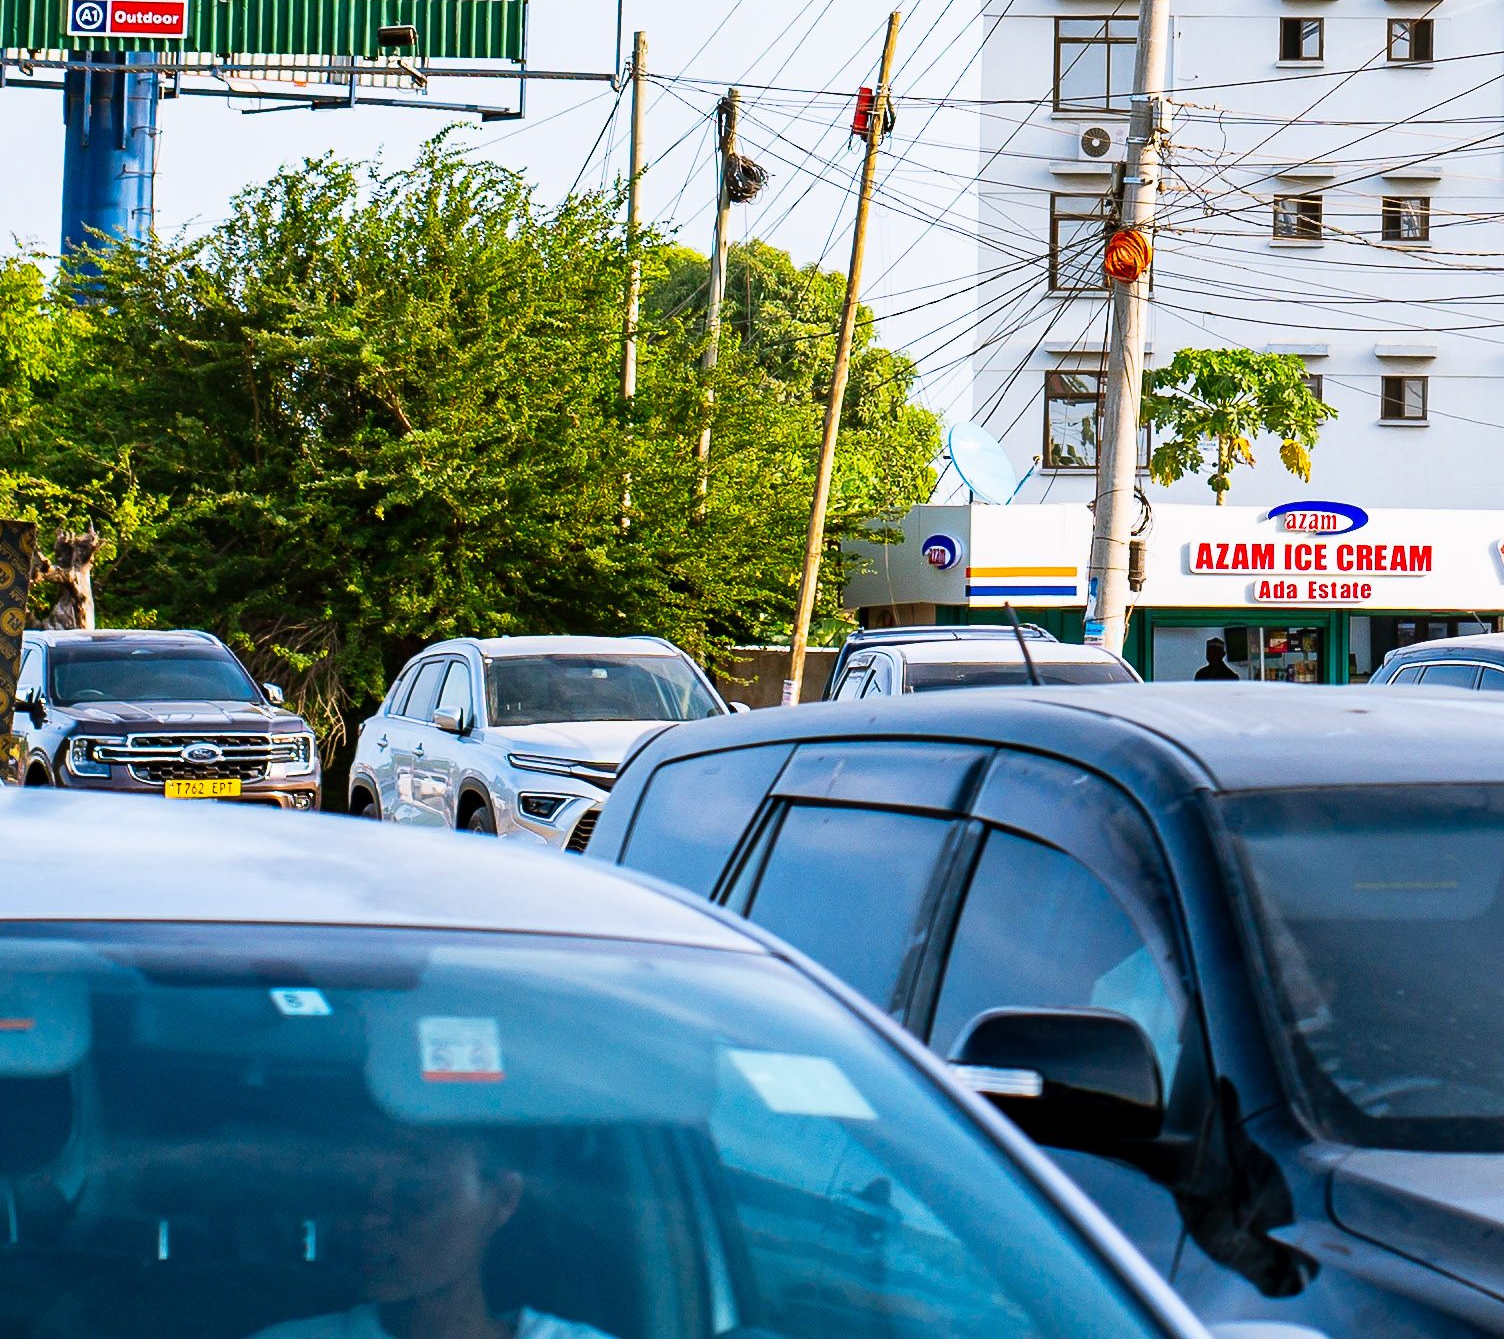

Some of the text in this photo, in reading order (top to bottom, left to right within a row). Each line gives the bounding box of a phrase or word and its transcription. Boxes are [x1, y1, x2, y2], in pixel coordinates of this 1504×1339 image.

[81, 8, 179, 25] A1 Outdoor
[1285, 512, 1338, 531] azam
[1196, 543, 1432, 572] AZAM ICE CREAM
[1259, 580, 1372, 599] Ada Estate
[212, 782, 233, 794] EPT
